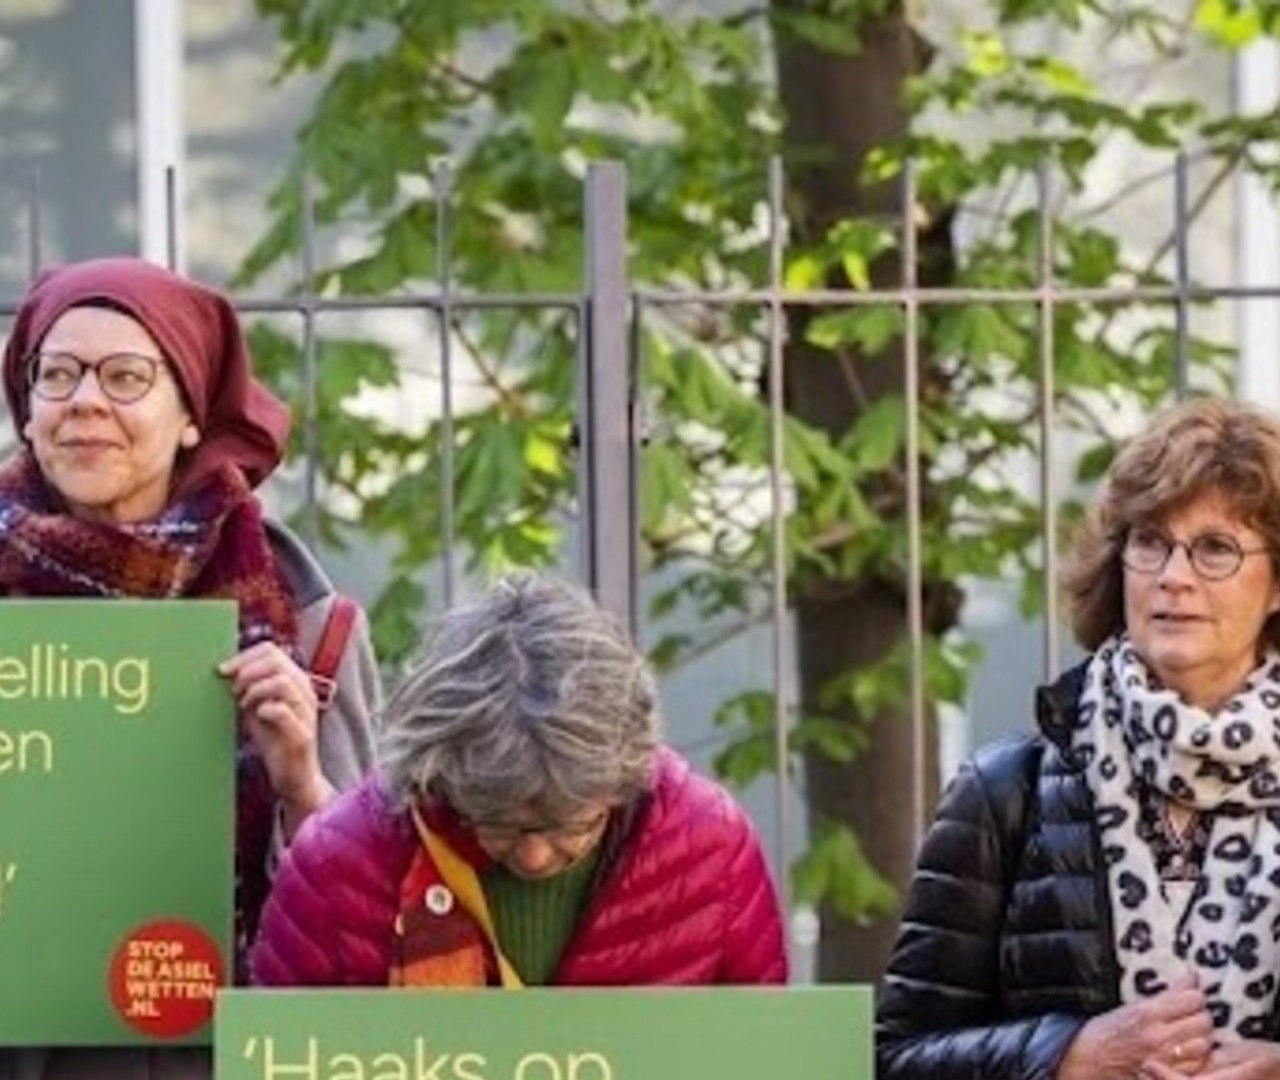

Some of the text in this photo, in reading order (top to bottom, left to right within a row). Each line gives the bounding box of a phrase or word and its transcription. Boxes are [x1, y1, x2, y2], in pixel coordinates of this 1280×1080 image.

[128, 941, 183, 959] STOP
[126, 960, 215, 979] DE ASIEL
[125, 980, 215, 999] WETTEN
[125, 1000, 161, 1017] .NL
